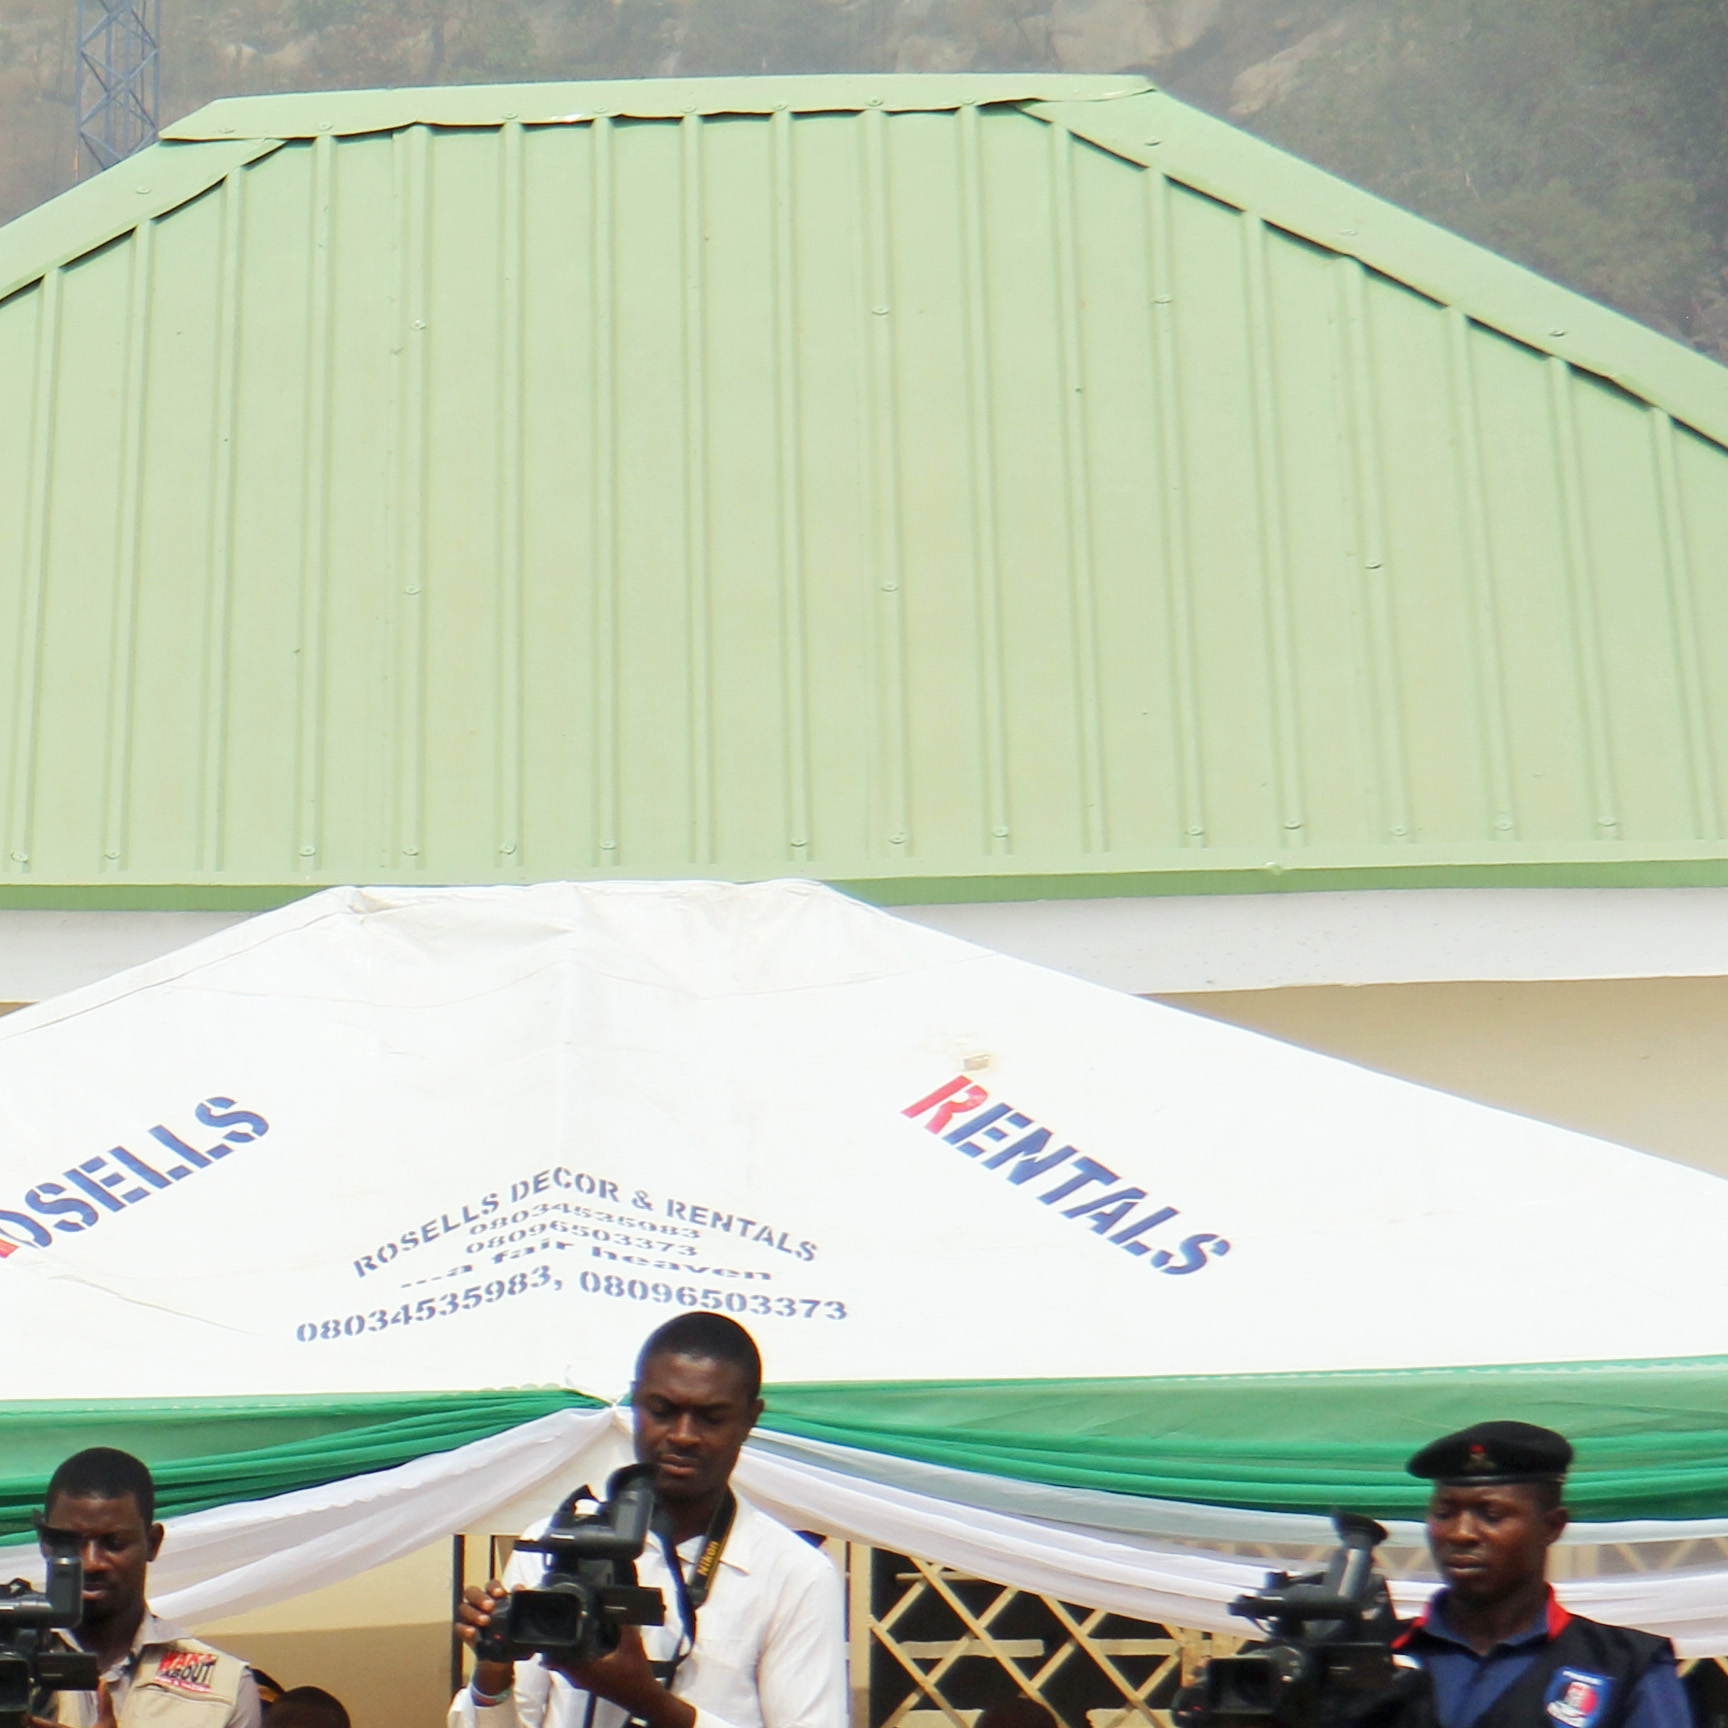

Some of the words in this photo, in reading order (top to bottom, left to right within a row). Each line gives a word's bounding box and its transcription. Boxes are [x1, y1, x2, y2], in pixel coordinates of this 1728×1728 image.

[353, 1192, 501, 1278] ROSELLS
[510, 1166, 621, 1203] DECOR
[632, 1189, 654, 1212] &
[666, 1197, 819, 1262] RENTALS
[899, 1074, 1231, 1275] RENTALS
[296, 1264, 564, 1343] 08034535983,
[579, 1270, 848, 1321] 08096503373
[491, 1238, 576, 1265] fair
[591, 1245, 773, 1281] heaven
